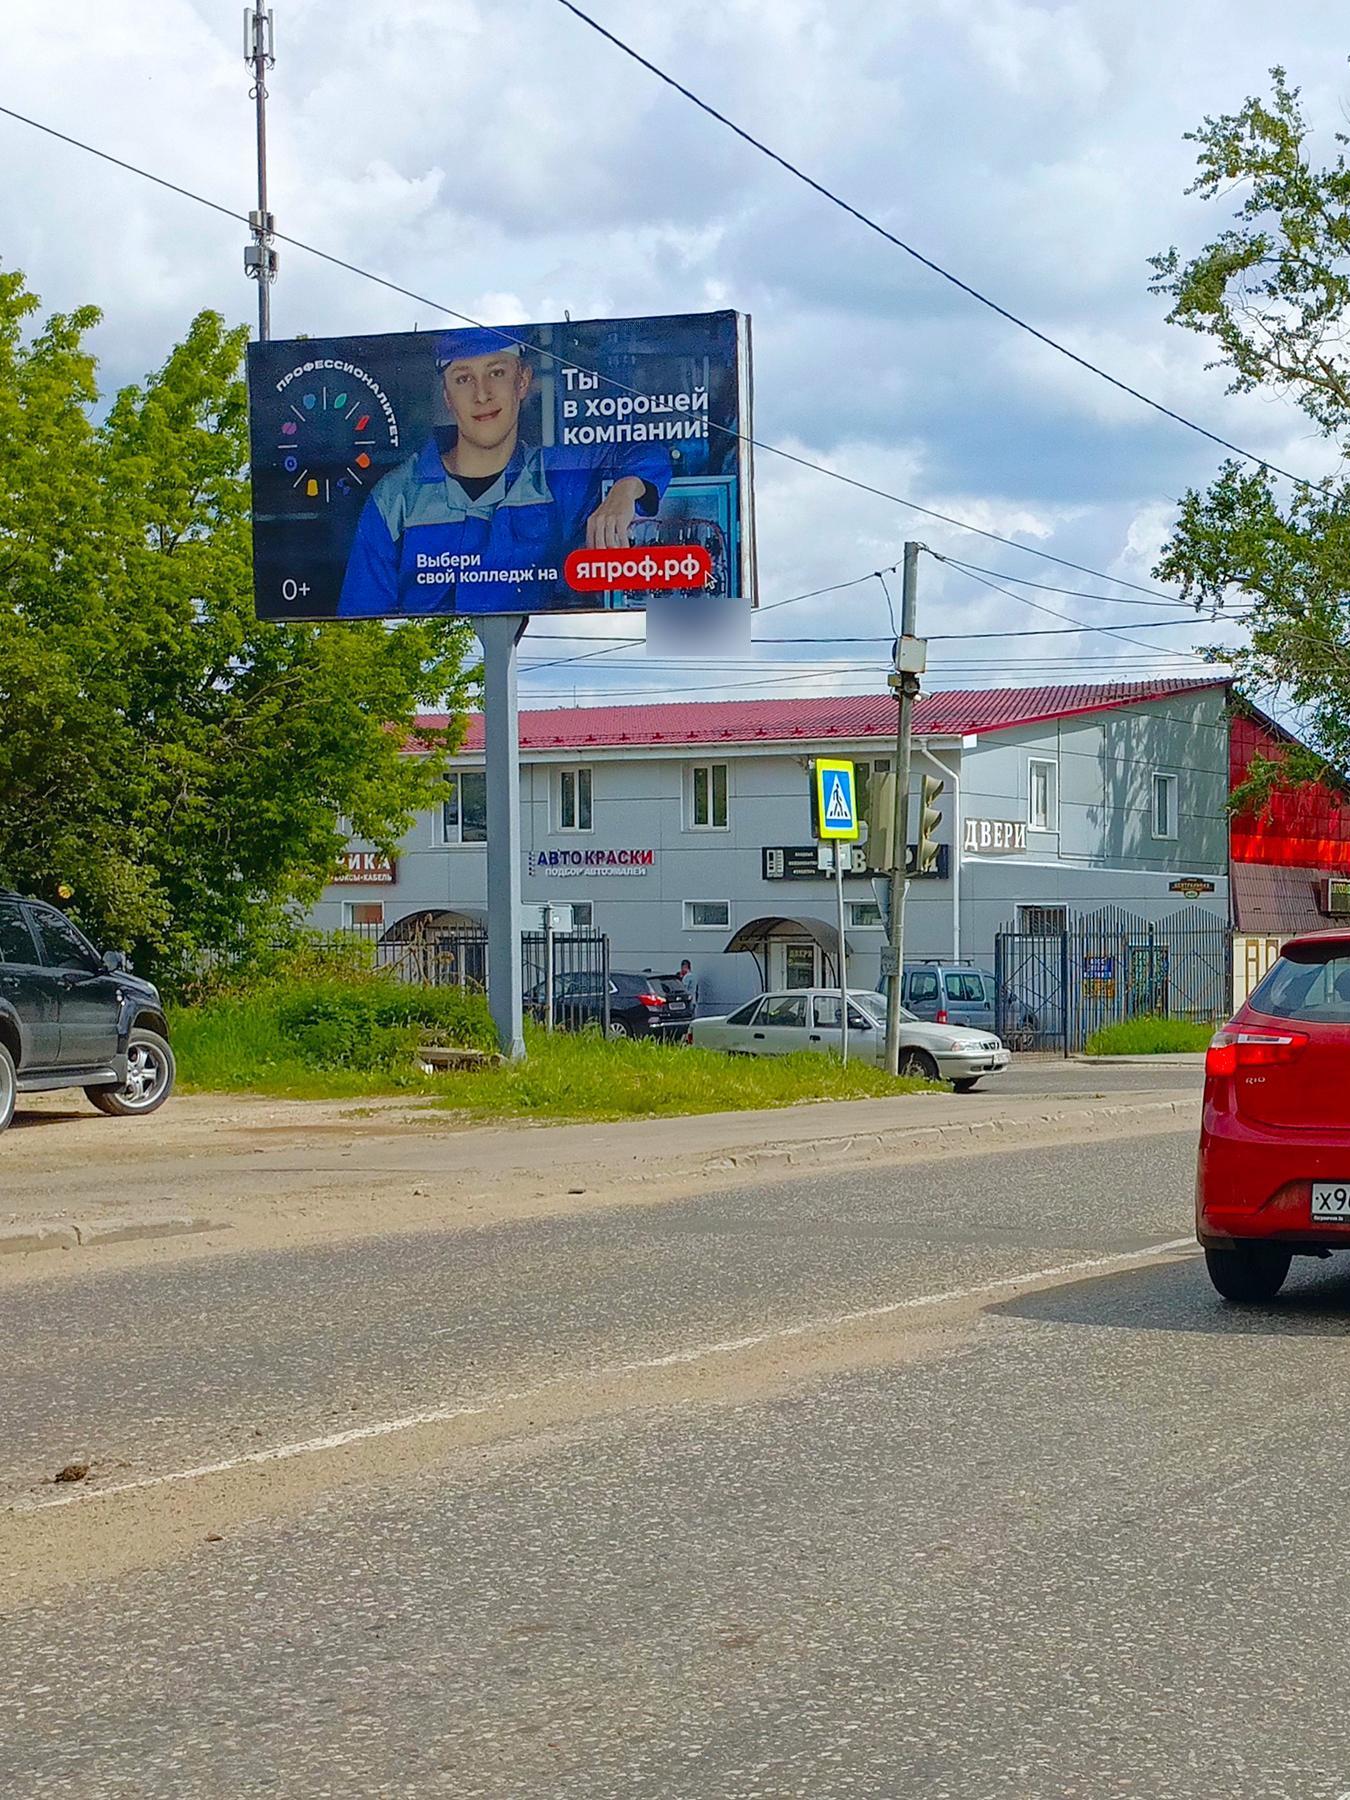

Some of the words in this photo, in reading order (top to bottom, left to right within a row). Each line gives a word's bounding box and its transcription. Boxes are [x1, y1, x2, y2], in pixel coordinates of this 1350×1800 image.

[562, 368, 599, 390] Ты
[276, 359, 399, 447] ПРОФЕССИОНАЛИТЕТ
[564, 400, 578, 417] в
[585, 387, 709, 420] хорошей
[563, 415, 709, 444] компании!
[416, 552, 481, 569] Выбери
[576, 553, 700, 582] япроф.рф
[416, 569, 456, 584] свой
[460, 569, 534, 583] колледж
[538, 568, 558, 580] на
[282, 579, 310, 600] 0+
[965, 820, 1026, 851] ДВЕРИ
[1245, 1076, 1266, 1085] RIO
